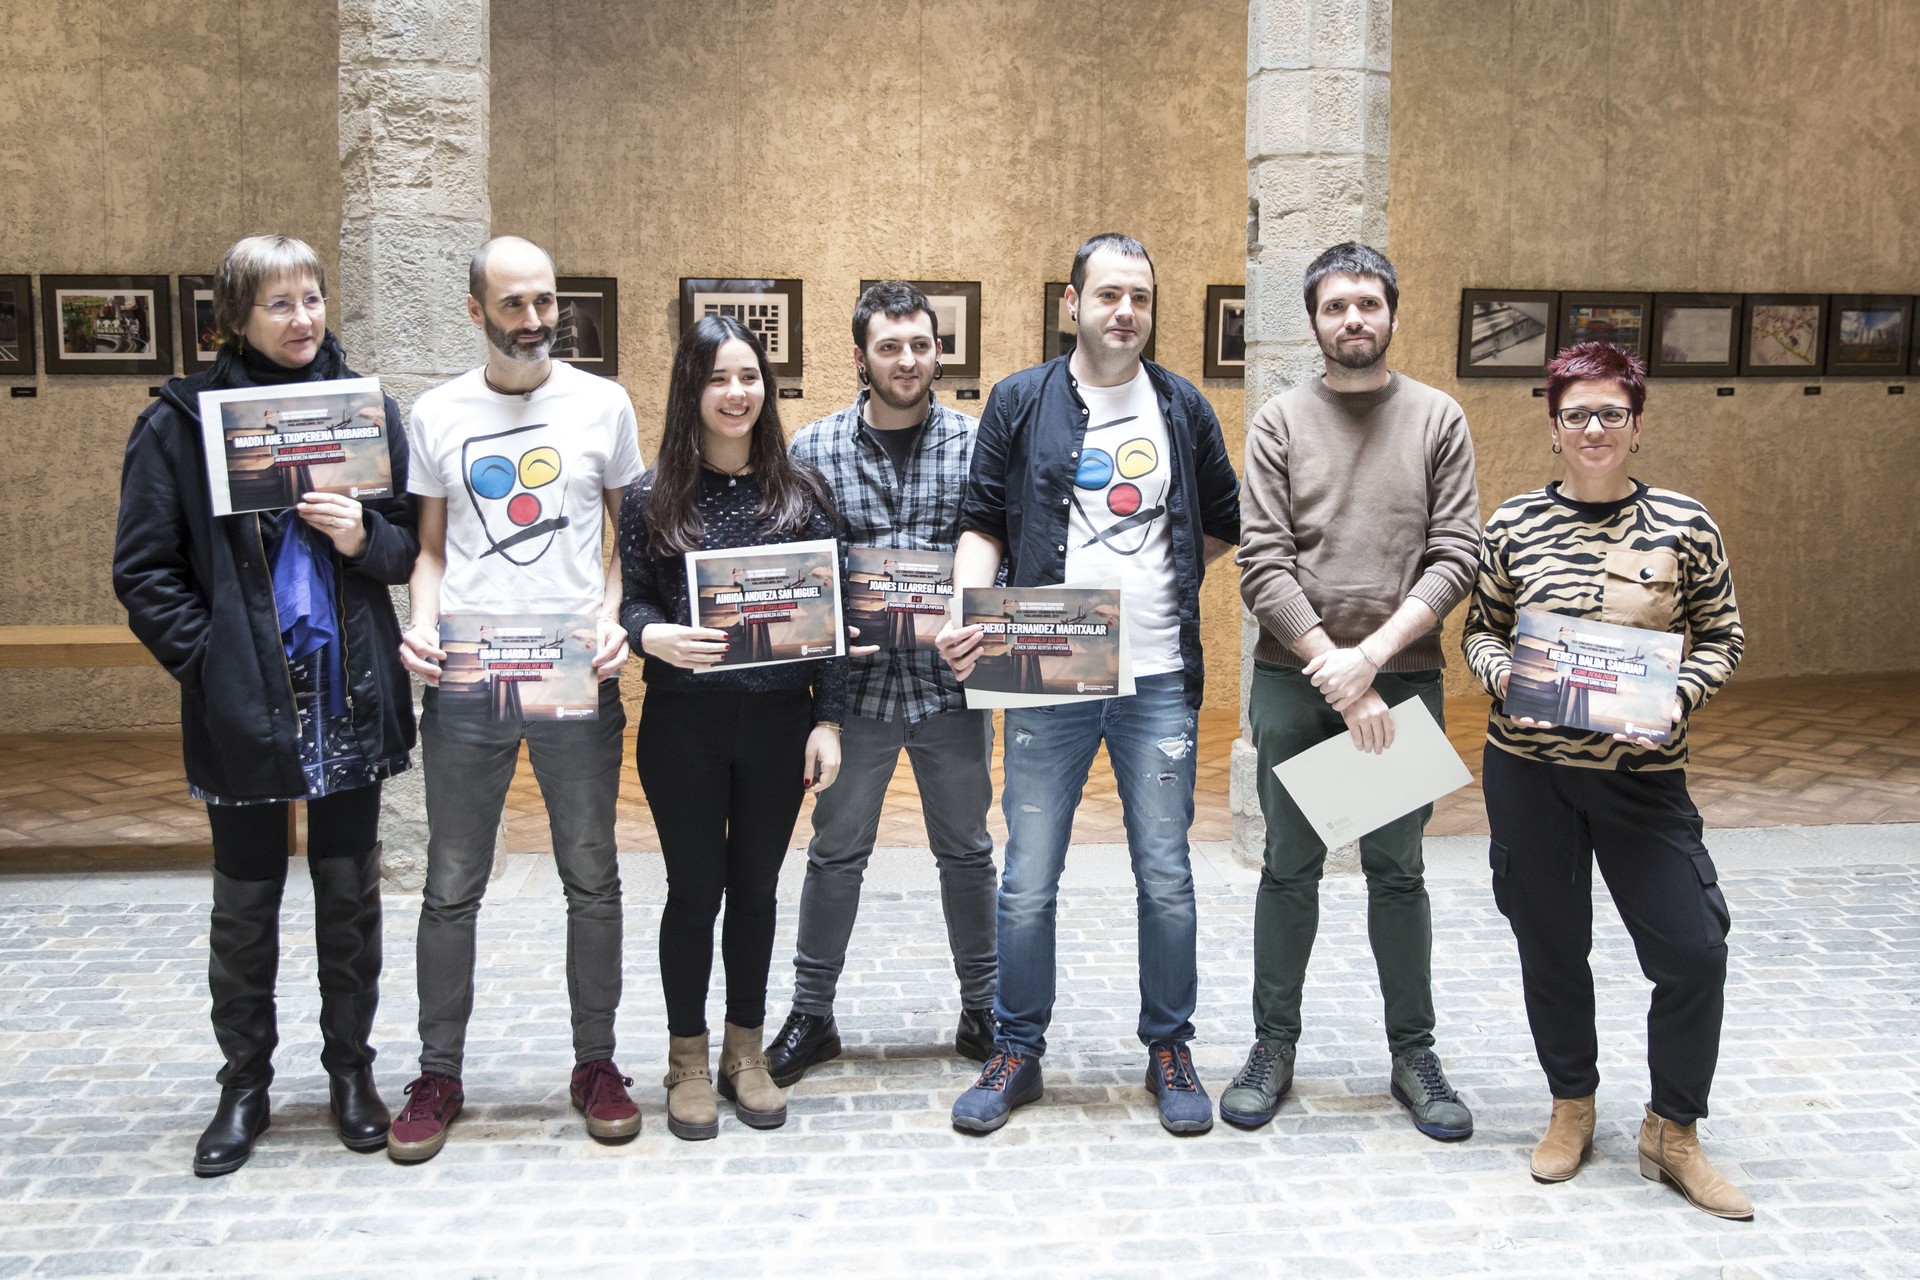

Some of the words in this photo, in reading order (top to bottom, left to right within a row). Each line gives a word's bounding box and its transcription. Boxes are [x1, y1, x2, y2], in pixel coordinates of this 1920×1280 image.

[235, 437, 263, 448] MADDI
[265, 434, 283, 445] ANE
[284, 430, 333, 444] TXOPERENA
[335, 427, 379, 440] IRIBARREN
[869, 581, 896, 591] JOANES
[898, 582, 935, 594] ILLARREGI
[936, 584, 953, 594] MAR
[716, 593, 744, 604] AINHOA
[745, 590, 777, 602] ANDUEZA
[778, 589, 793, 600] SAN
[793, 587, 820, 599] MIGUEL
[980, 624, 1005, 634] ENEKO
[1007, 624, 1054, 634] FERNANDEZ
[1056, 624, 1106, 635] MARITXALAR
[531, 649, 560, 659] ALZURI
[1549, 649, 1577, 664] NEREA
[1578, 653, 1606, 669] BALDA
